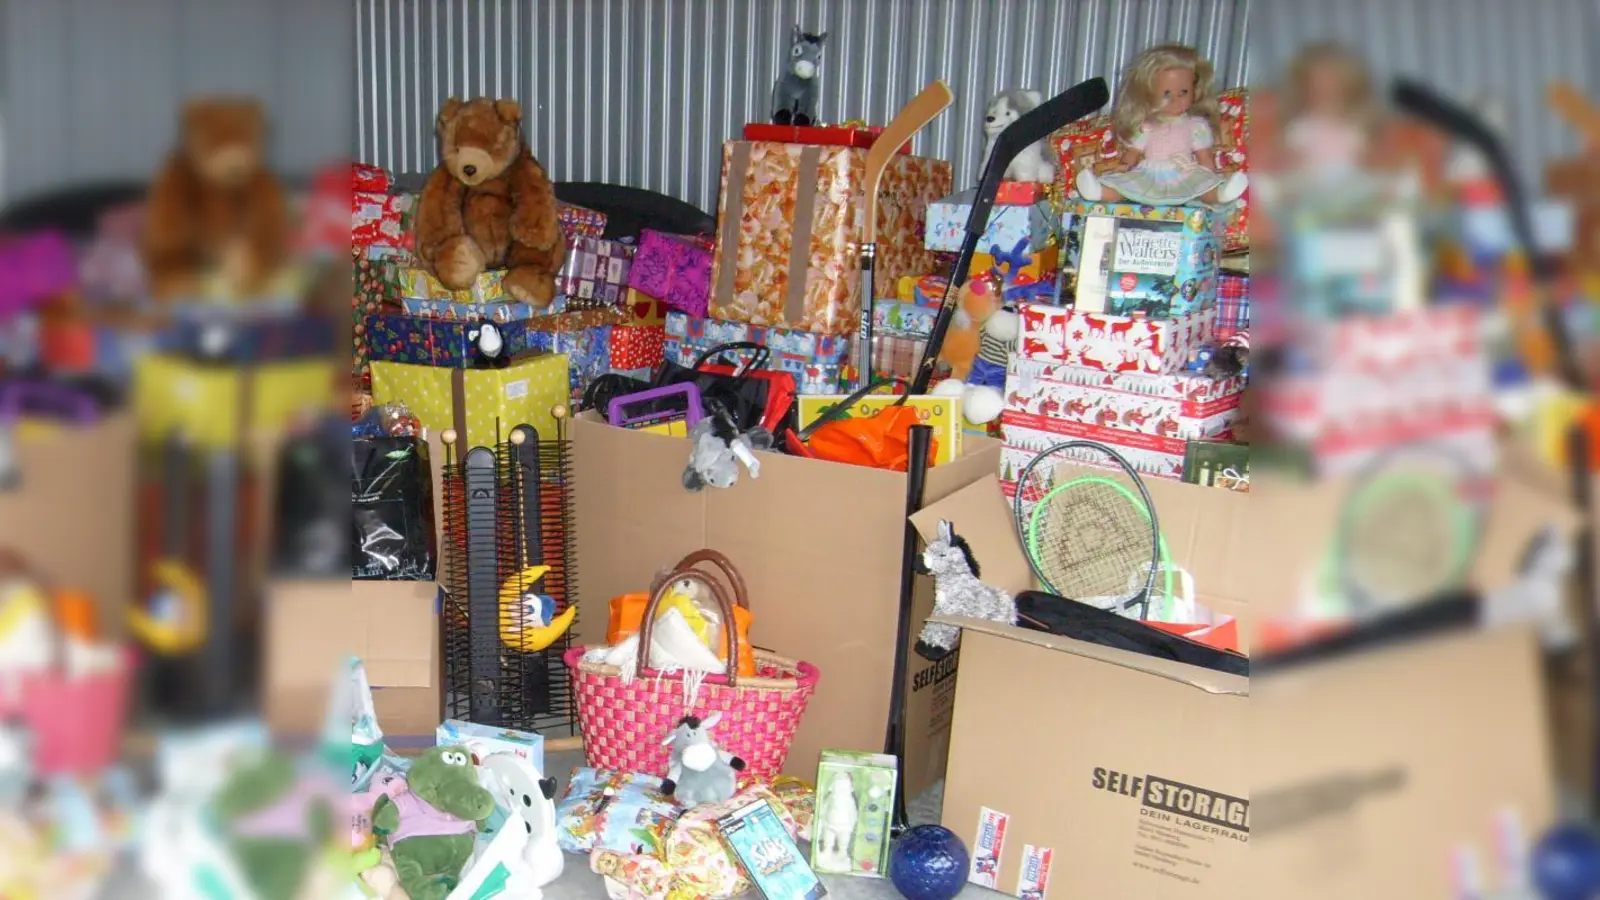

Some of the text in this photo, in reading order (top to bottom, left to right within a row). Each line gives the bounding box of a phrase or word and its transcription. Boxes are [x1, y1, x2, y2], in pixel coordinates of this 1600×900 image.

[913, 664, 936, 692] SELF
[1092, 767, 1143, 798] SELF
[1140, 808, 1170, 822] DEIN
